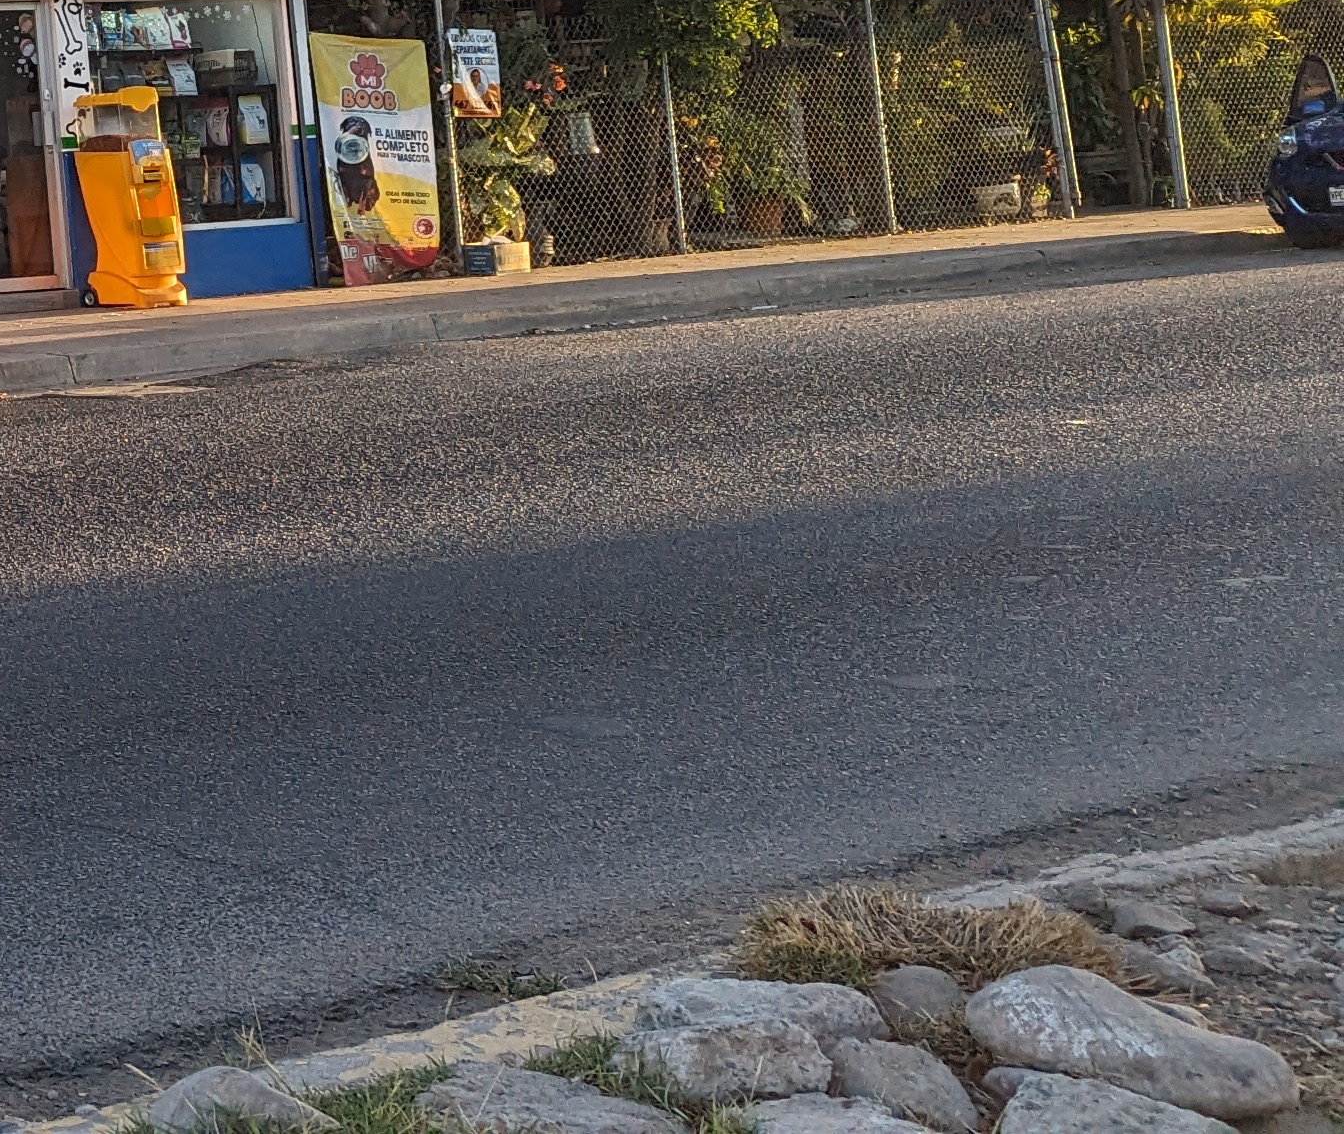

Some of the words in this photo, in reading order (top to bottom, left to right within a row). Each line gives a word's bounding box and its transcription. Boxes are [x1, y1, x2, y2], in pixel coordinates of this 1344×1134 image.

[341, 88, 397, 111] BOOB
[375, 128, 383, 136] EL
[385, 129, 428, 141] ALIMENTO
[375, 139, 430, 153] COMPLETO
[397, 152, 430, 164] MASCOTA
